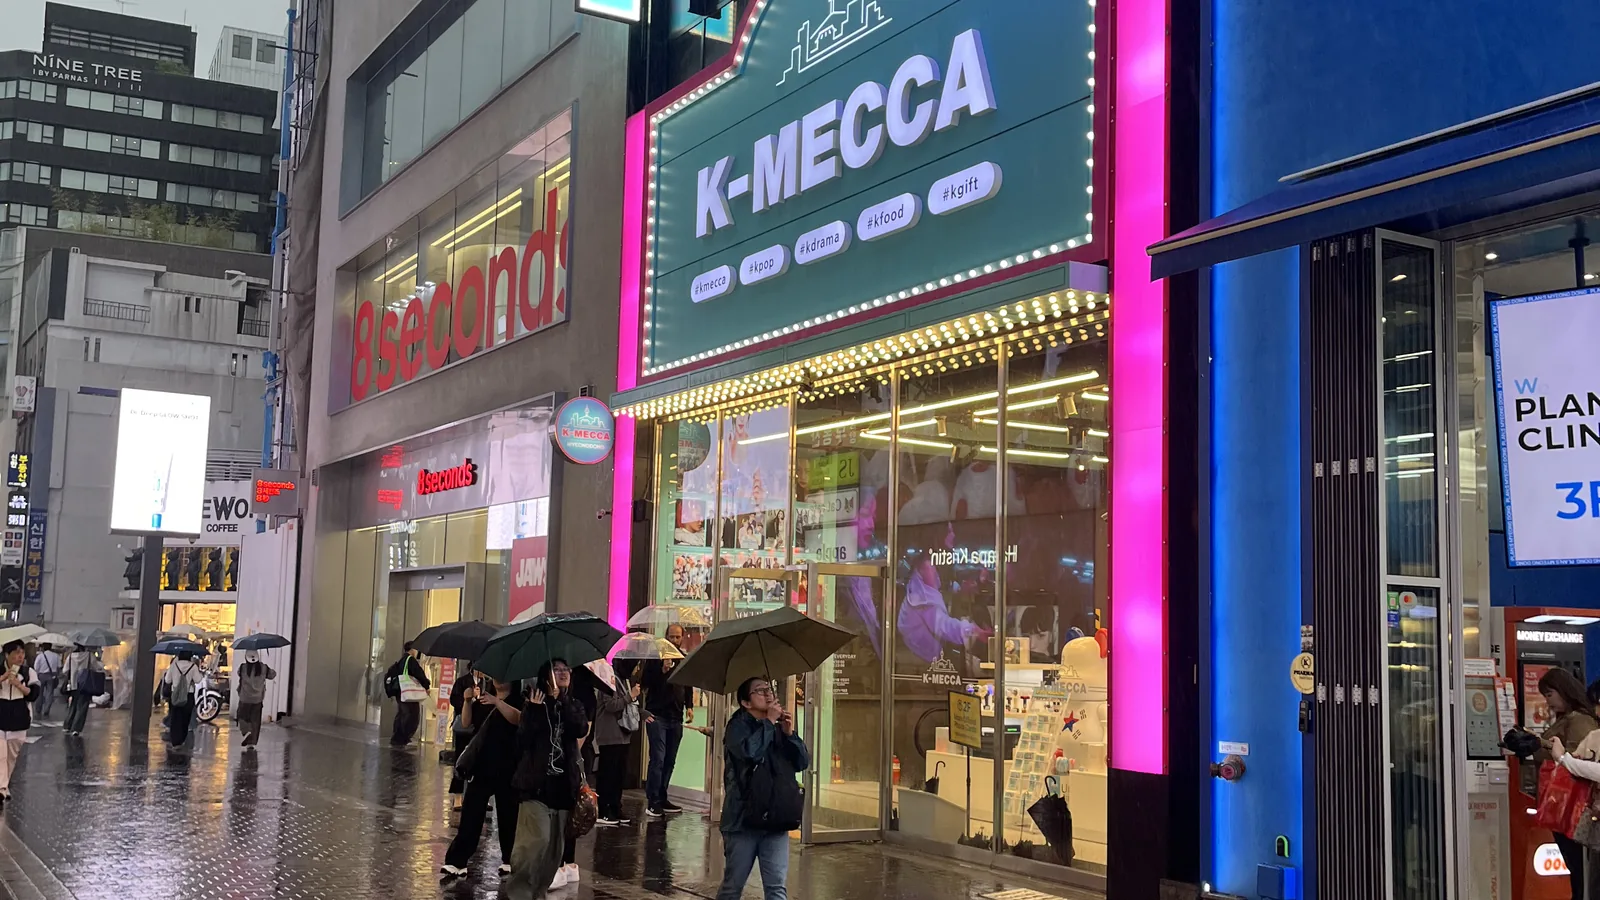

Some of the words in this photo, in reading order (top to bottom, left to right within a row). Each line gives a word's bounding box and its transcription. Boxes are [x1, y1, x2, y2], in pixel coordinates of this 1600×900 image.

[38, 69, 49, 77] BY
[52, 71, 88, 83] PARNAS
[91, 63, 142, 82] TREE
[696, 28, 997, 238] K-MECCA
[694, 275, 726, 295] #kmecca
[749, 257, 774, 275] #kpop
[800, 230, 840, 256] #kdrama
[867, 204, 904, 230] #kfood
[942, 176, 979, 202] #kgift
[562, 427, 611, 440] K-MECCA
[417, 458, 473, 495] 8seconds
[256, 479, 295, 490] 8seconds
[206, 523, 238, 532] COFFEE
[516, 557, 546, 588] JAW
[1517, 630, 1544, 641] MONEY
[1544, 631, 1584, 644] EXCHANGE
[922, 673, 962, 686] K-MECCA
[1040, 680, 1087, 694] K-MECCA
